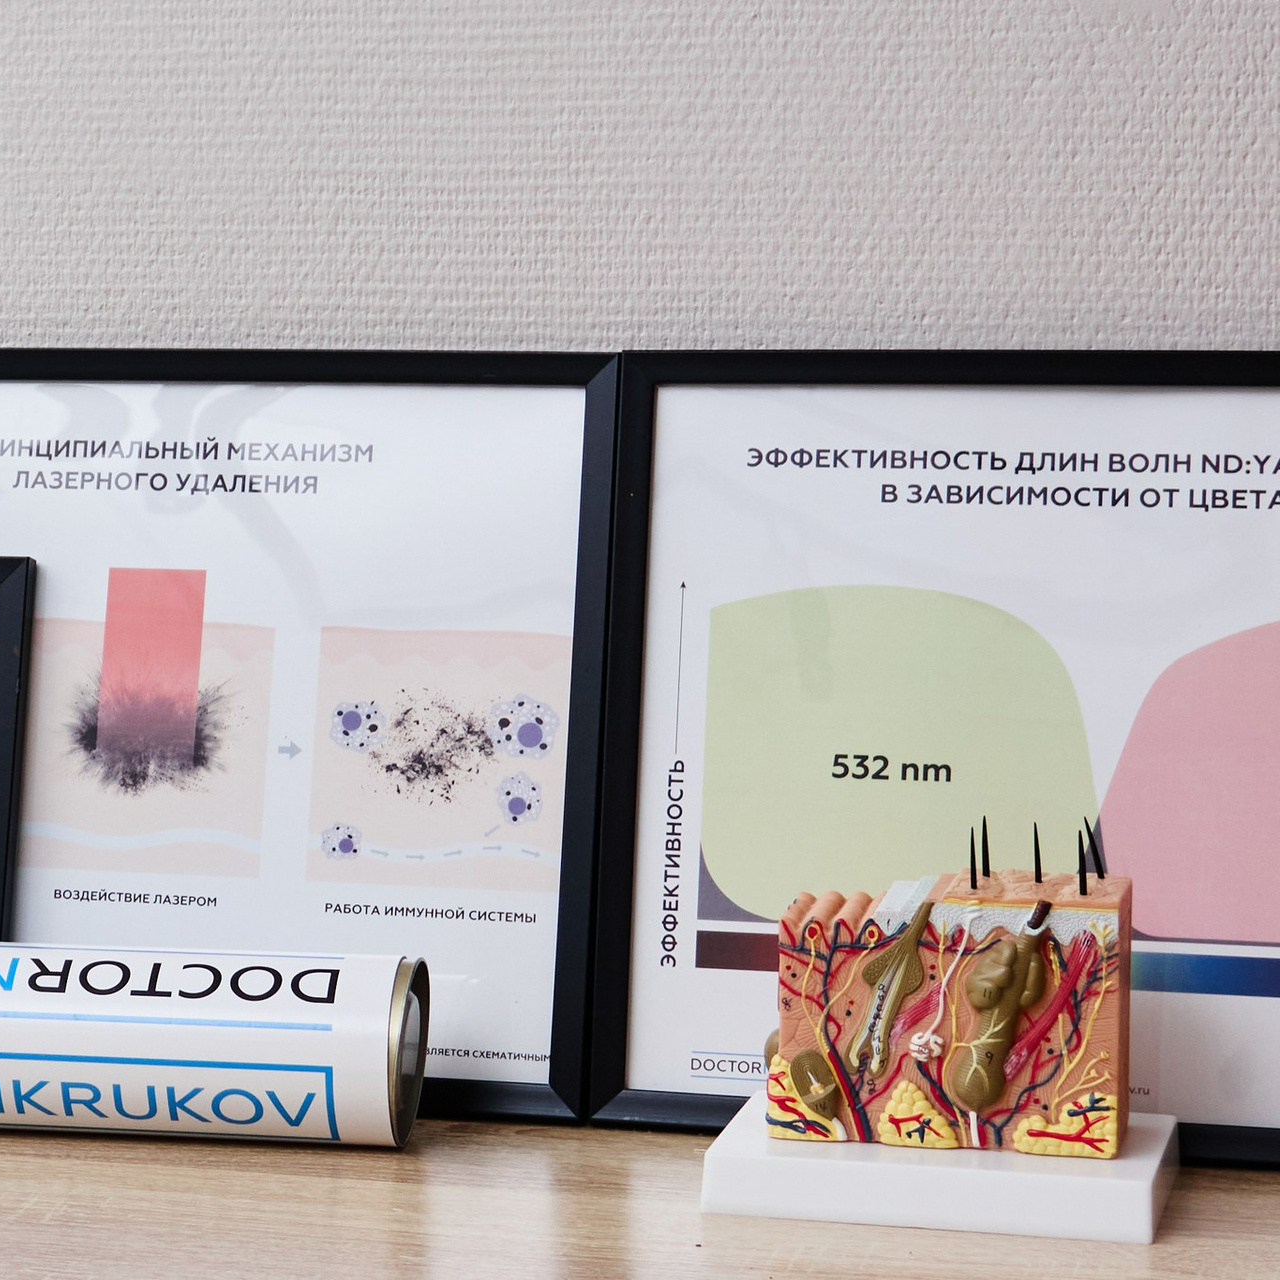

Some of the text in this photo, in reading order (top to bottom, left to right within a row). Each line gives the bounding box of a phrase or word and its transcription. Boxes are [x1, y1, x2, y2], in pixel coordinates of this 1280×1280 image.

[227, 442, 373, 462] МЕХАНИЗМ
[747, 448, 1007, 470] ЭФФЕКТИВНОСТЬ
[1015, 452, 1098, 475] ДЛИН
[1109, 454, 1191, 473] ВОЛН
[13, 471, 317, 495] ЛАЗЕРНОГО УДАЛЕНИЯ
[881, 484, 1280, 512] В ЗАВИСИМОСТИ ОТ ЦВЕТА
[832, 754, 951, 782] 532 nm
[661, 760, 684, 967] ЭФФЕКТИВНОСТЬ
[54, 889, 216, 906] ВОЗДЕЙСТВИЕ ЛАЗЕРОМ
[325, 903, 536, 923] РАБОТА ИММУННОЙ СИСТЕМЫ
